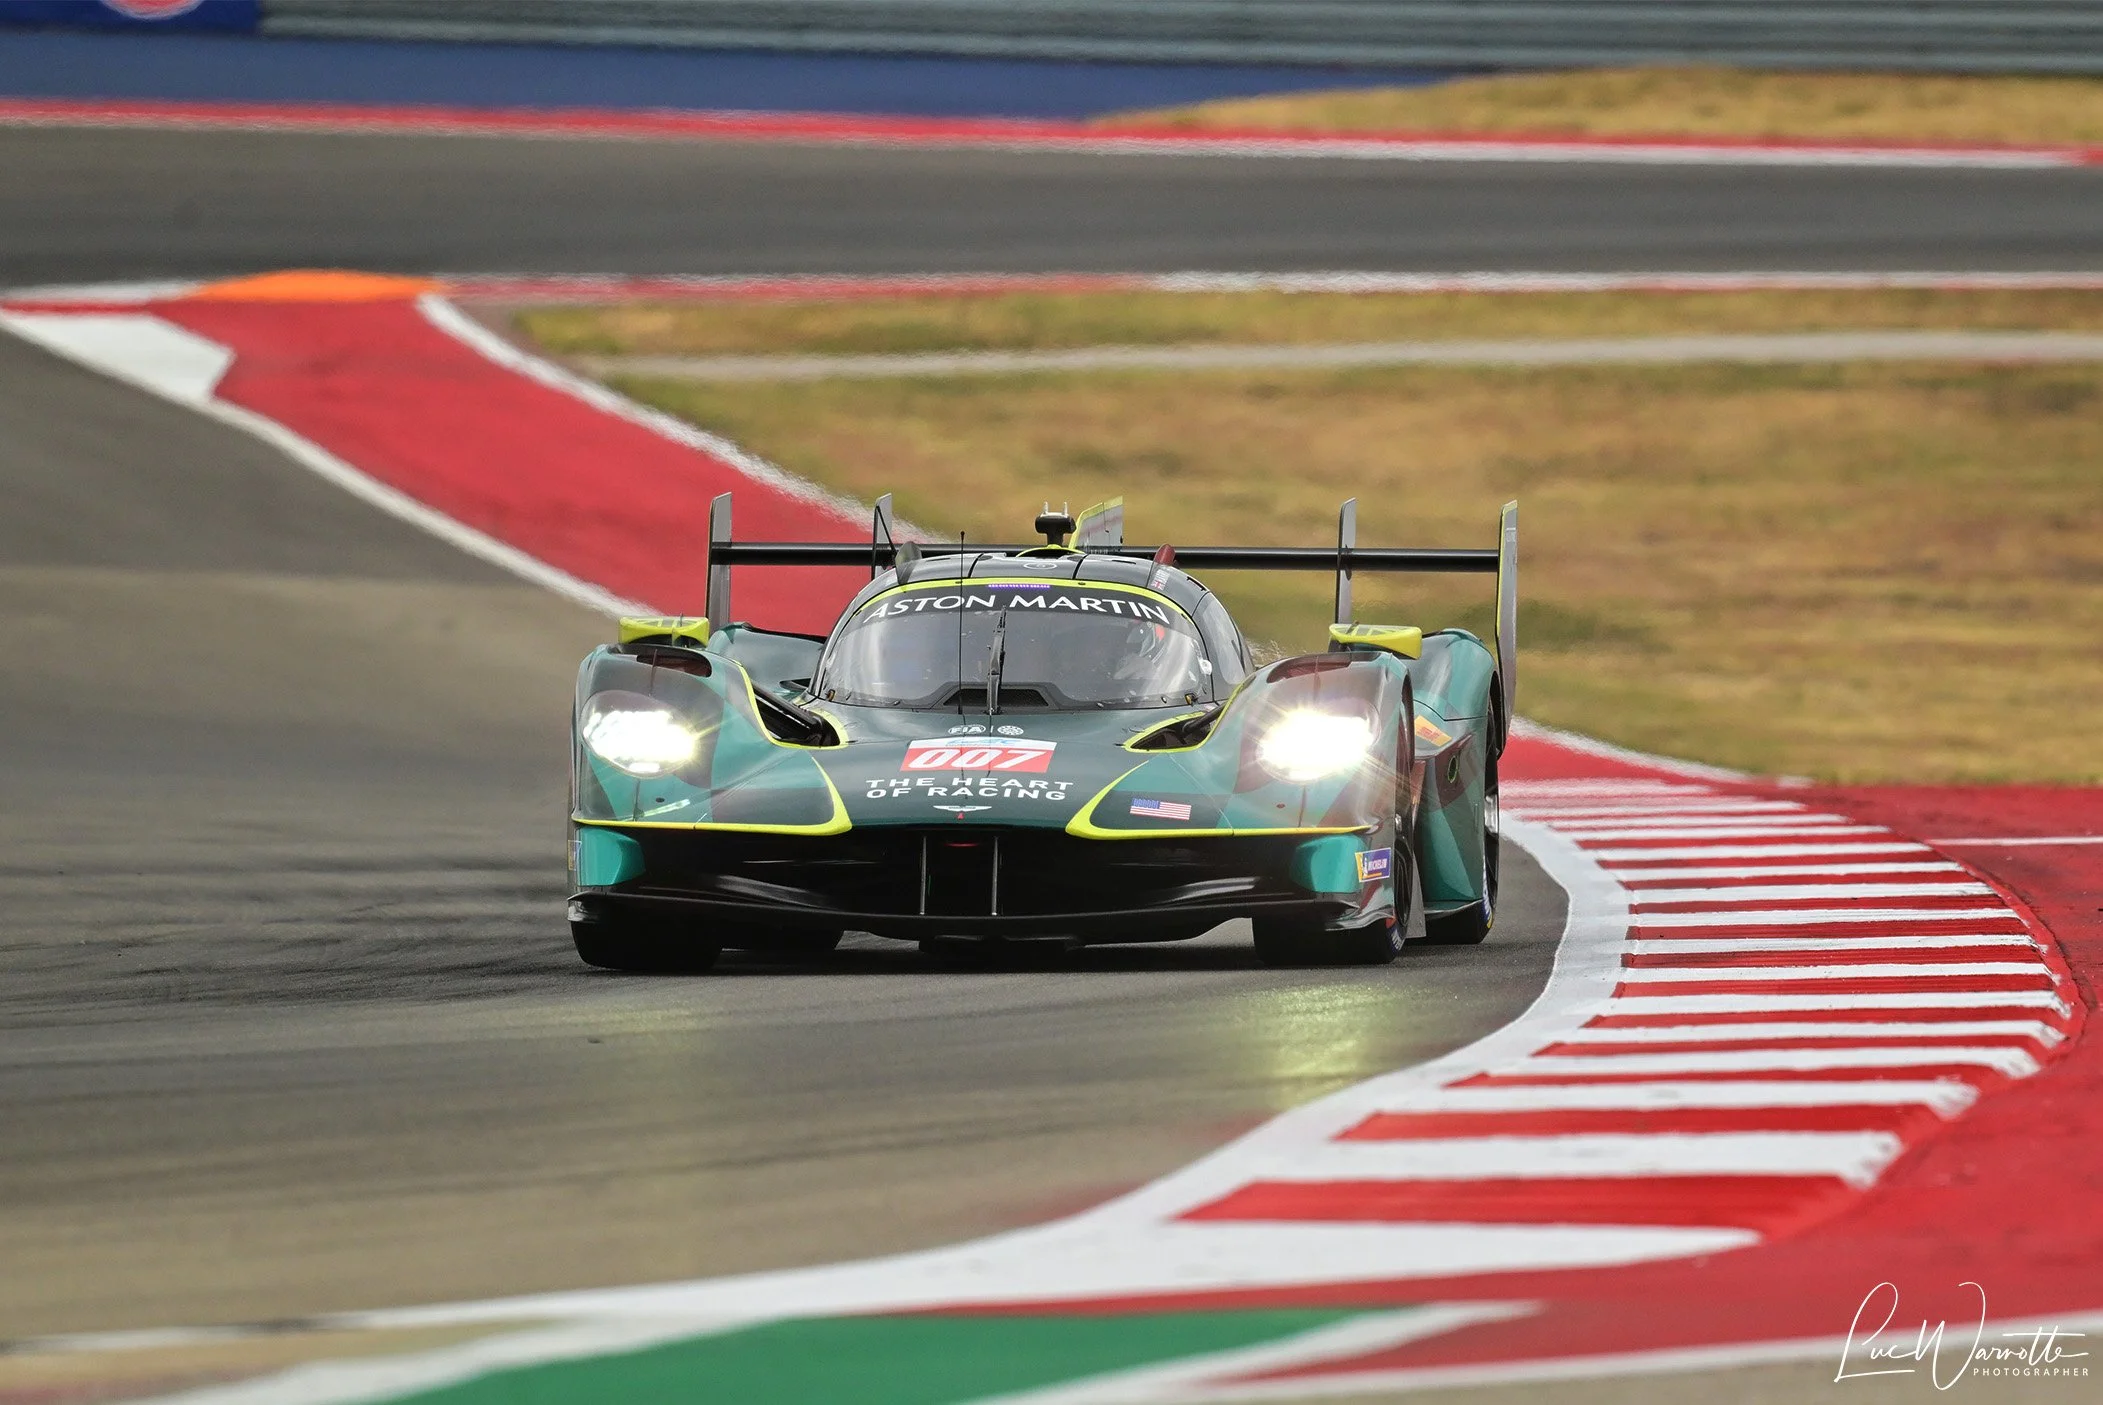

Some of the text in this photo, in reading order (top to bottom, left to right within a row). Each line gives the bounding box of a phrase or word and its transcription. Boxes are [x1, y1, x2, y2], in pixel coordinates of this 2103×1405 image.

[863, 594, 1170, 624] ASTON MARTIN
[951, 725, 983, 734] FIA
[908, 749, 1047, 769] 007
[866, 777, 1074, 791] THE HEART
[866, 786, 1067, 801] OF RACING
